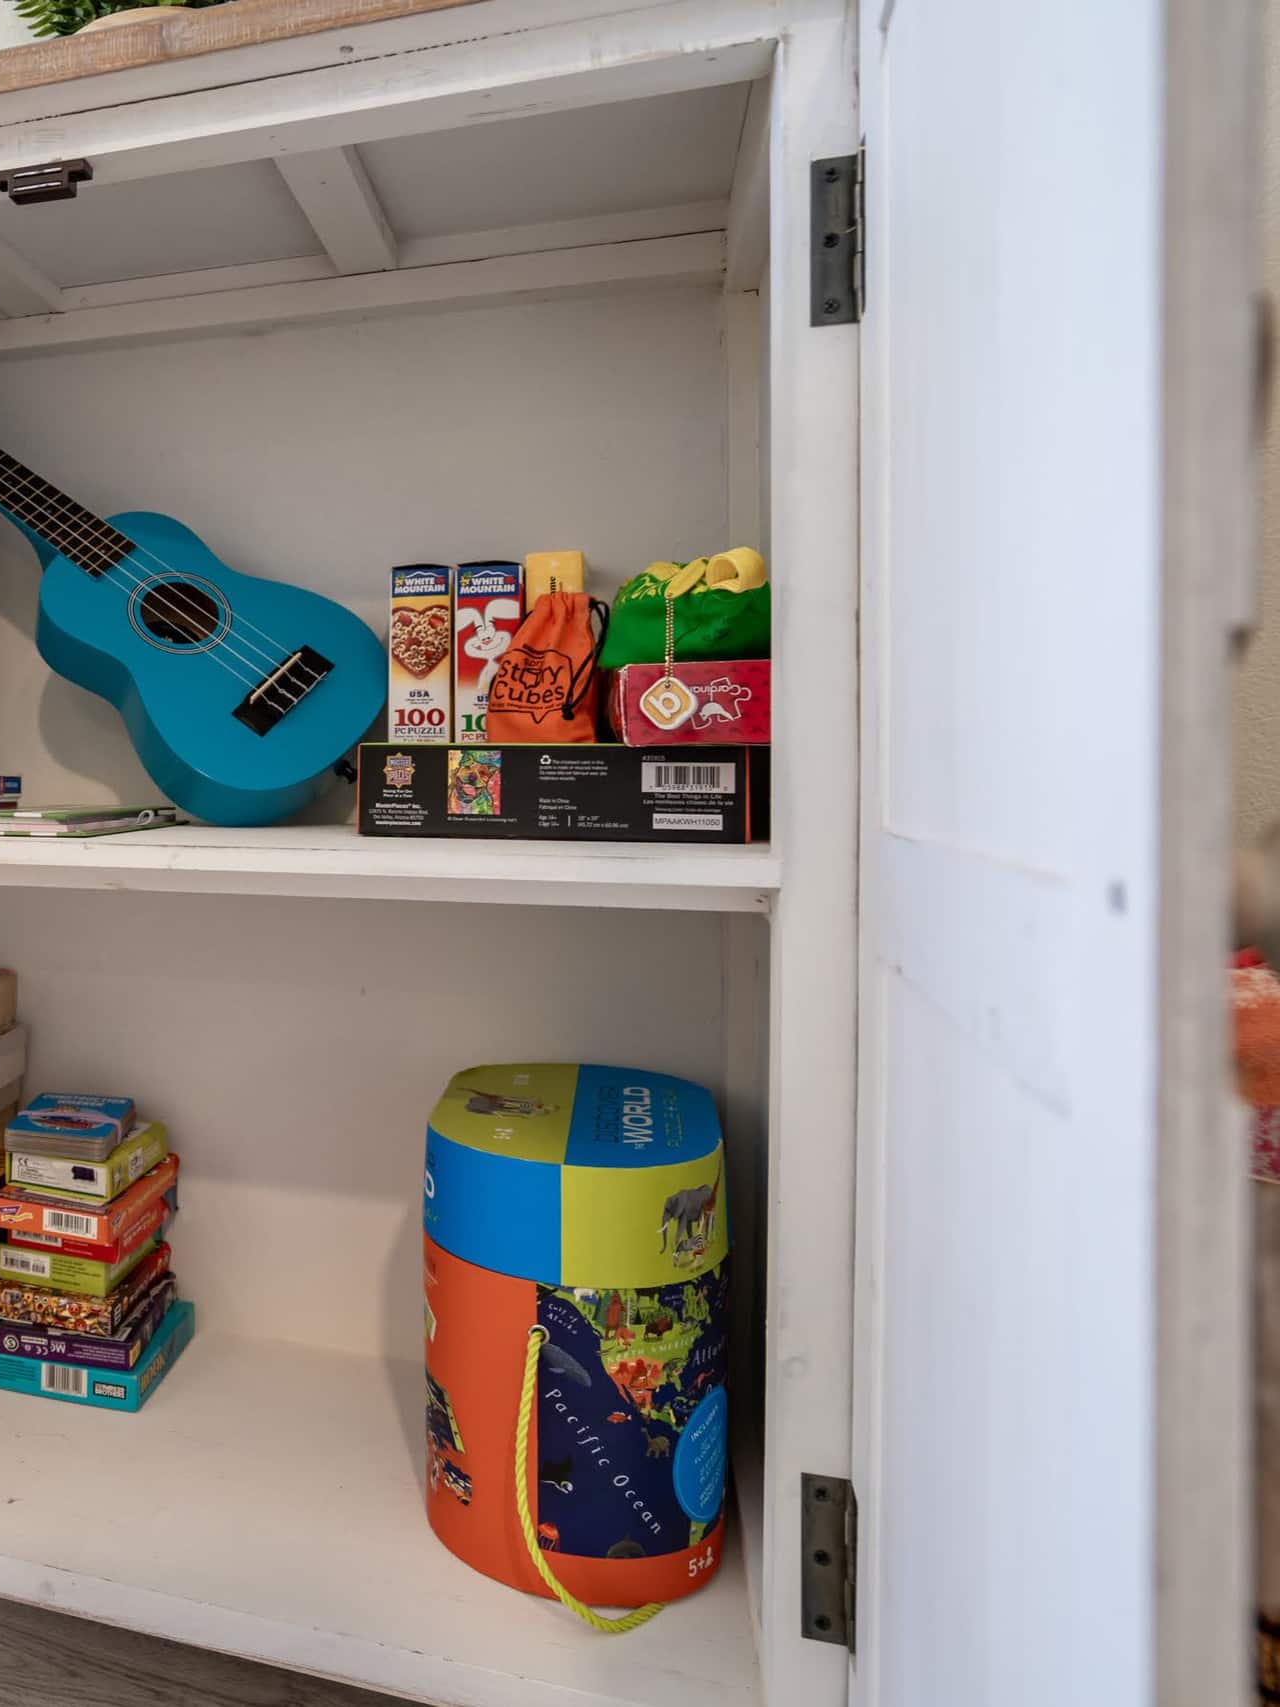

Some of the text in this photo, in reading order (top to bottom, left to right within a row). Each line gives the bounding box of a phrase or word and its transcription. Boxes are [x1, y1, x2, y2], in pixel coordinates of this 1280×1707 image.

[405, 577, 435, 585] WHITE
[472, 576, 504, 585] WHITE
[394, 584, 446, 594] MOUNTAIN
[460, 583, 516, 594] MOUNTAIN
[409, 690, 429, 698] USA
[494, 681, 564, 704] Cubes
[394, 708, 445, 727] 100
[395, 727, 445, 735] PC PUZZLE
[461, 733, 475, 741] PC
[622, 1086, 654, 1143] WORLD
[545, 1388, 662, 1536] Pacific Ocean
